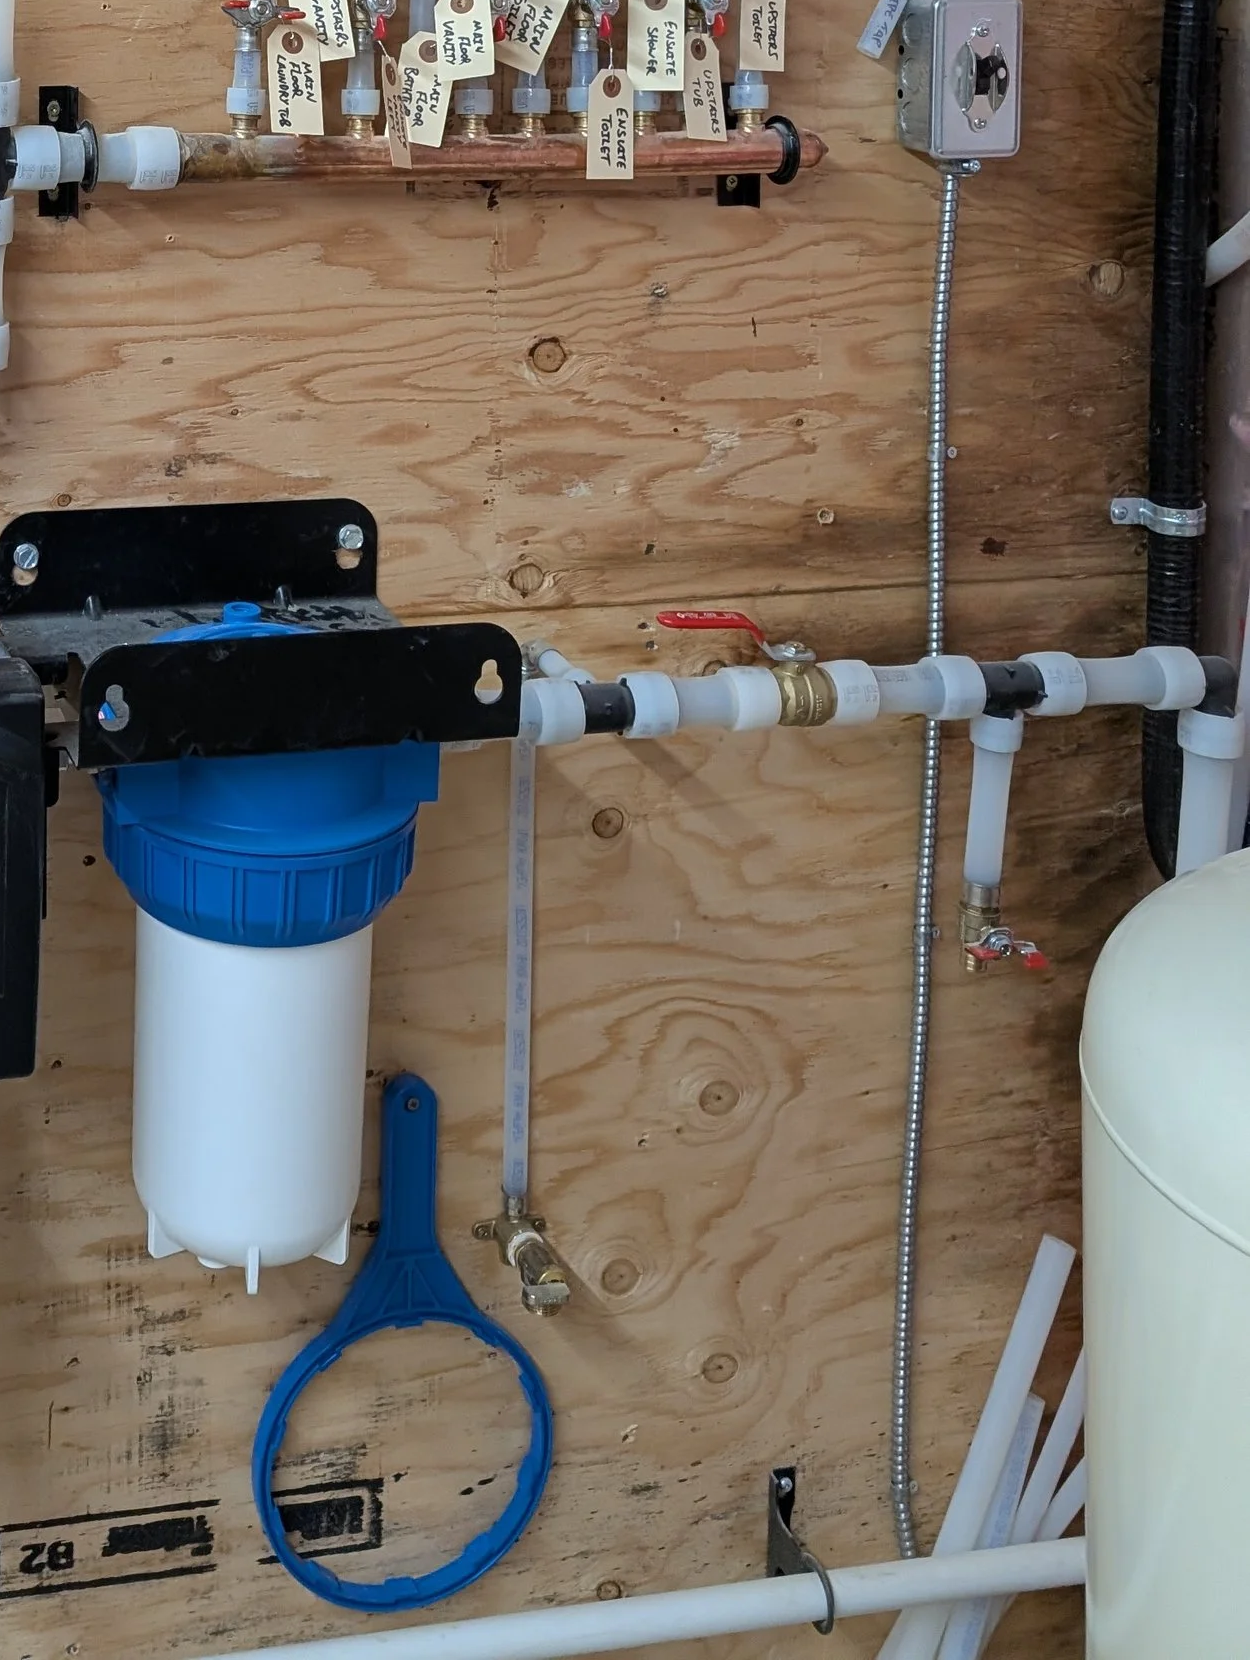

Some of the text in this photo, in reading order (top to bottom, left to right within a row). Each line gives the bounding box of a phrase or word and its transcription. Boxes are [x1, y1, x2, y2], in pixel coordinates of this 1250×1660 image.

[442, 20, 456, 66] VANITY
[472, 20, 486, 54] MAIN
[513, 3, 537, 43] FLOOR
[529, 5, 554, 56] MAIN
[752, 5, 764, 50] TOILET
[766, 0, 779, 61] UPSTAIRS
[458, 36, 472, 66] FLOOR
[645, 26, 659, 77] SHOWER
[663, 20, 678, 78] ENSUITE
[276, 54, 291, 128] LAUNDRY TUB
[288, 61, 304, 99] FLOOR
[301, 61, 317, 103] MAIN
[691, 77, 704, 108] TUB
[702, 69, 721, 136] UPSTAIRS
[411, 90, 428, 128] FLOOR
[600, 114, 613, 167] TOILET
[616, 107, 629, 170] ENSUITE
